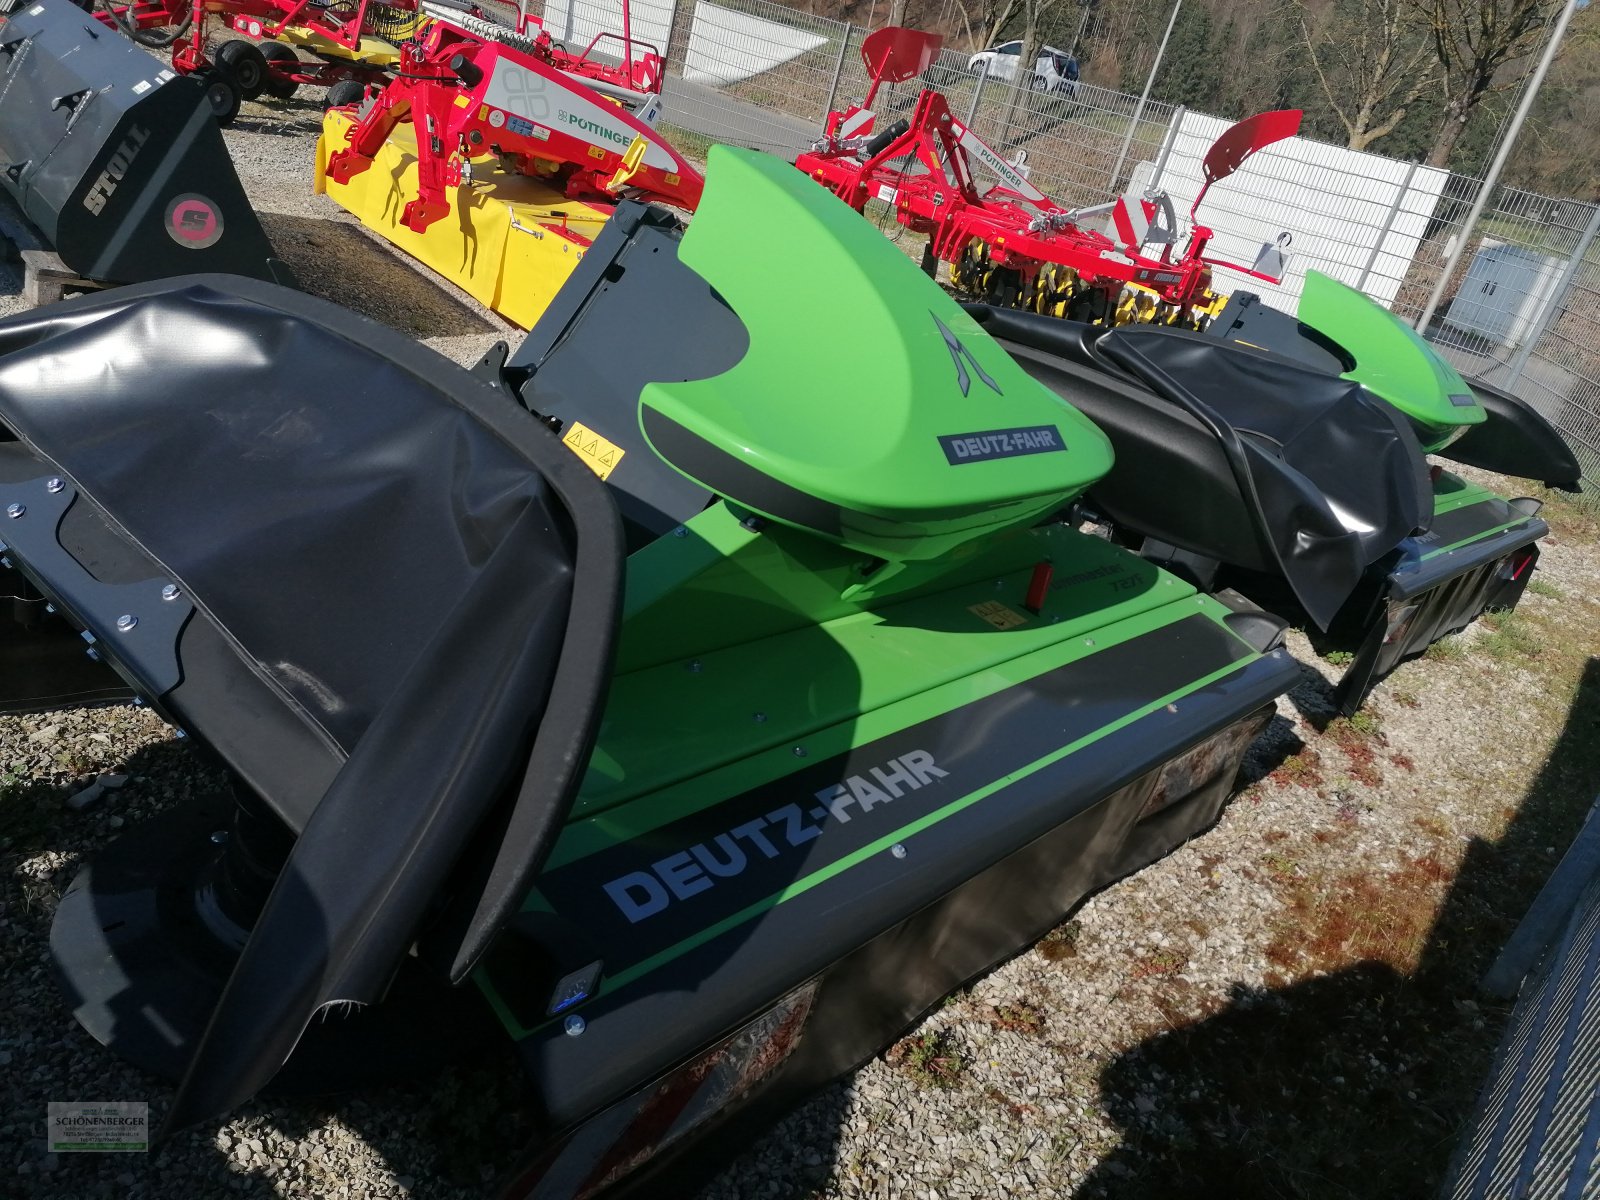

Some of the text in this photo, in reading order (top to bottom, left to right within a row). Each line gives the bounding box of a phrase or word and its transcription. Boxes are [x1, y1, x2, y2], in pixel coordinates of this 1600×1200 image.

[83, 123, 151, 216] STOLL
[951, 429, 1057, 458] DEUTZ-FAHR
[602, 749, 950, 924] DEUTZ-FAHR
